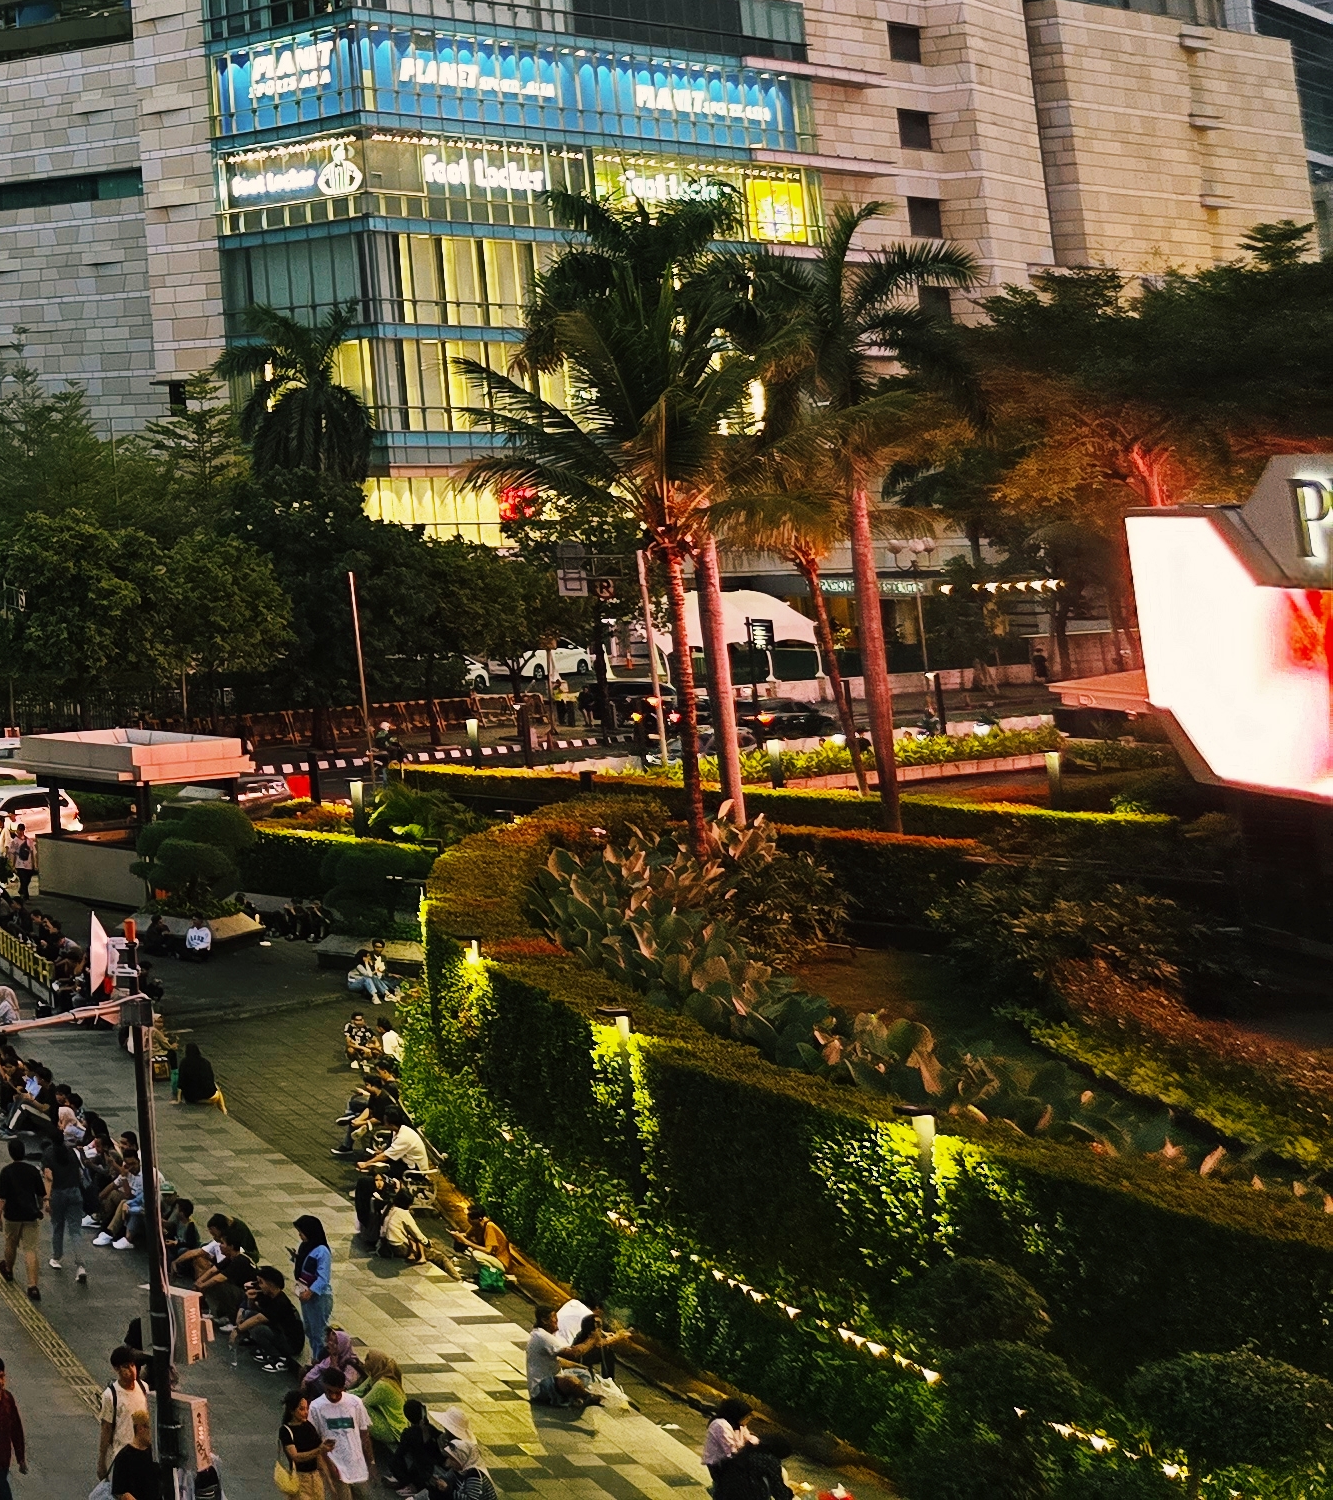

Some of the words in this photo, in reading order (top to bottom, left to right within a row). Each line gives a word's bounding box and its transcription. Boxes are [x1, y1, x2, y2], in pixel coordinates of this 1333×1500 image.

[399, 57, 479, 88] PLANET
[423, 153, 470, 185] Foot
[473, 158, 545, 192] Locker
